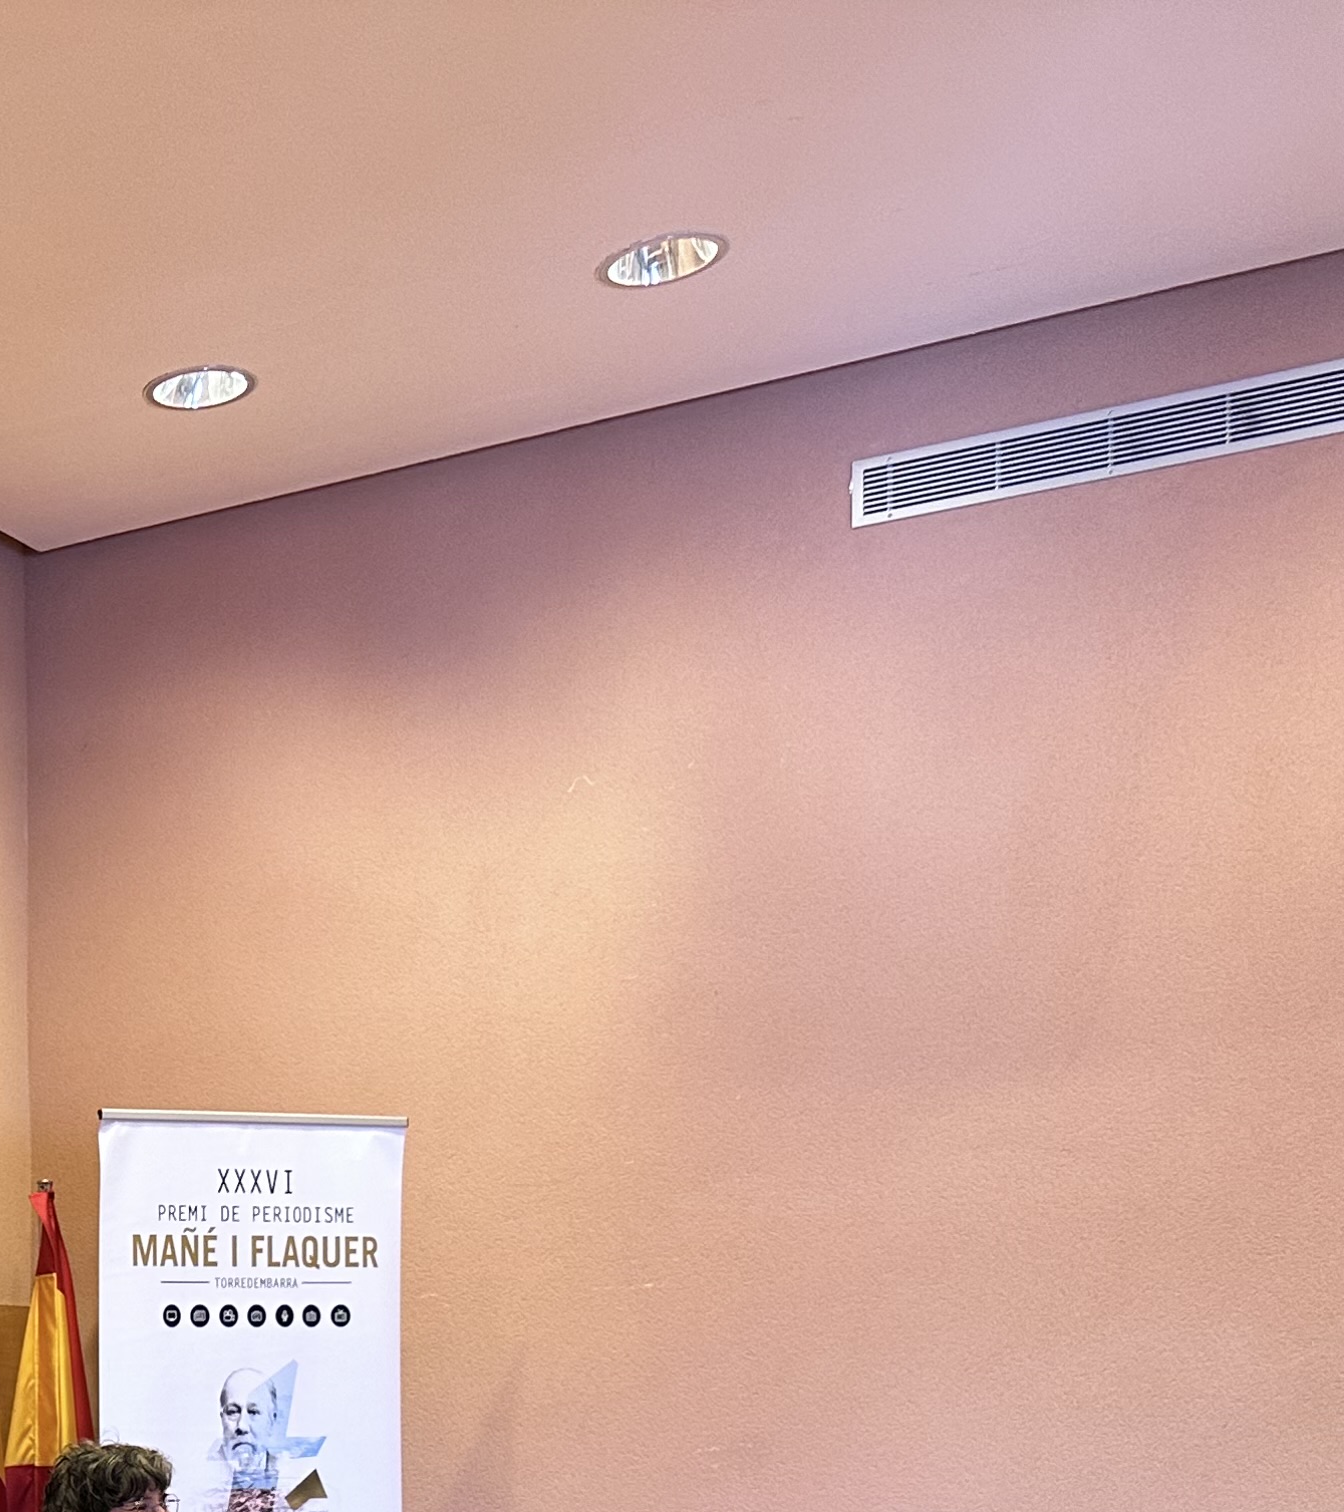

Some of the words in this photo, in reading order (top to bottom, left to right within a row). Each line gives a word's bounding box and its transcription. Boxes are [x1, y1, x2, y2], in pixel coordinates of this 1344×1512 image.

[218, 1168, 294, 1195] XXXVI
[158, 1204, 207, 1222] PREMI
[220, 1205, 241, 1223] DE
[252, 1206, 355, 1224] PERIODISME
[132, 1226, 218, 1267] MAÑÉ
[231, 1234, 238, 1267] I
[251, 1235, 379, 1269] FLAQUER
[215, 1277, 299, 1289] TORREDEMBARRA
